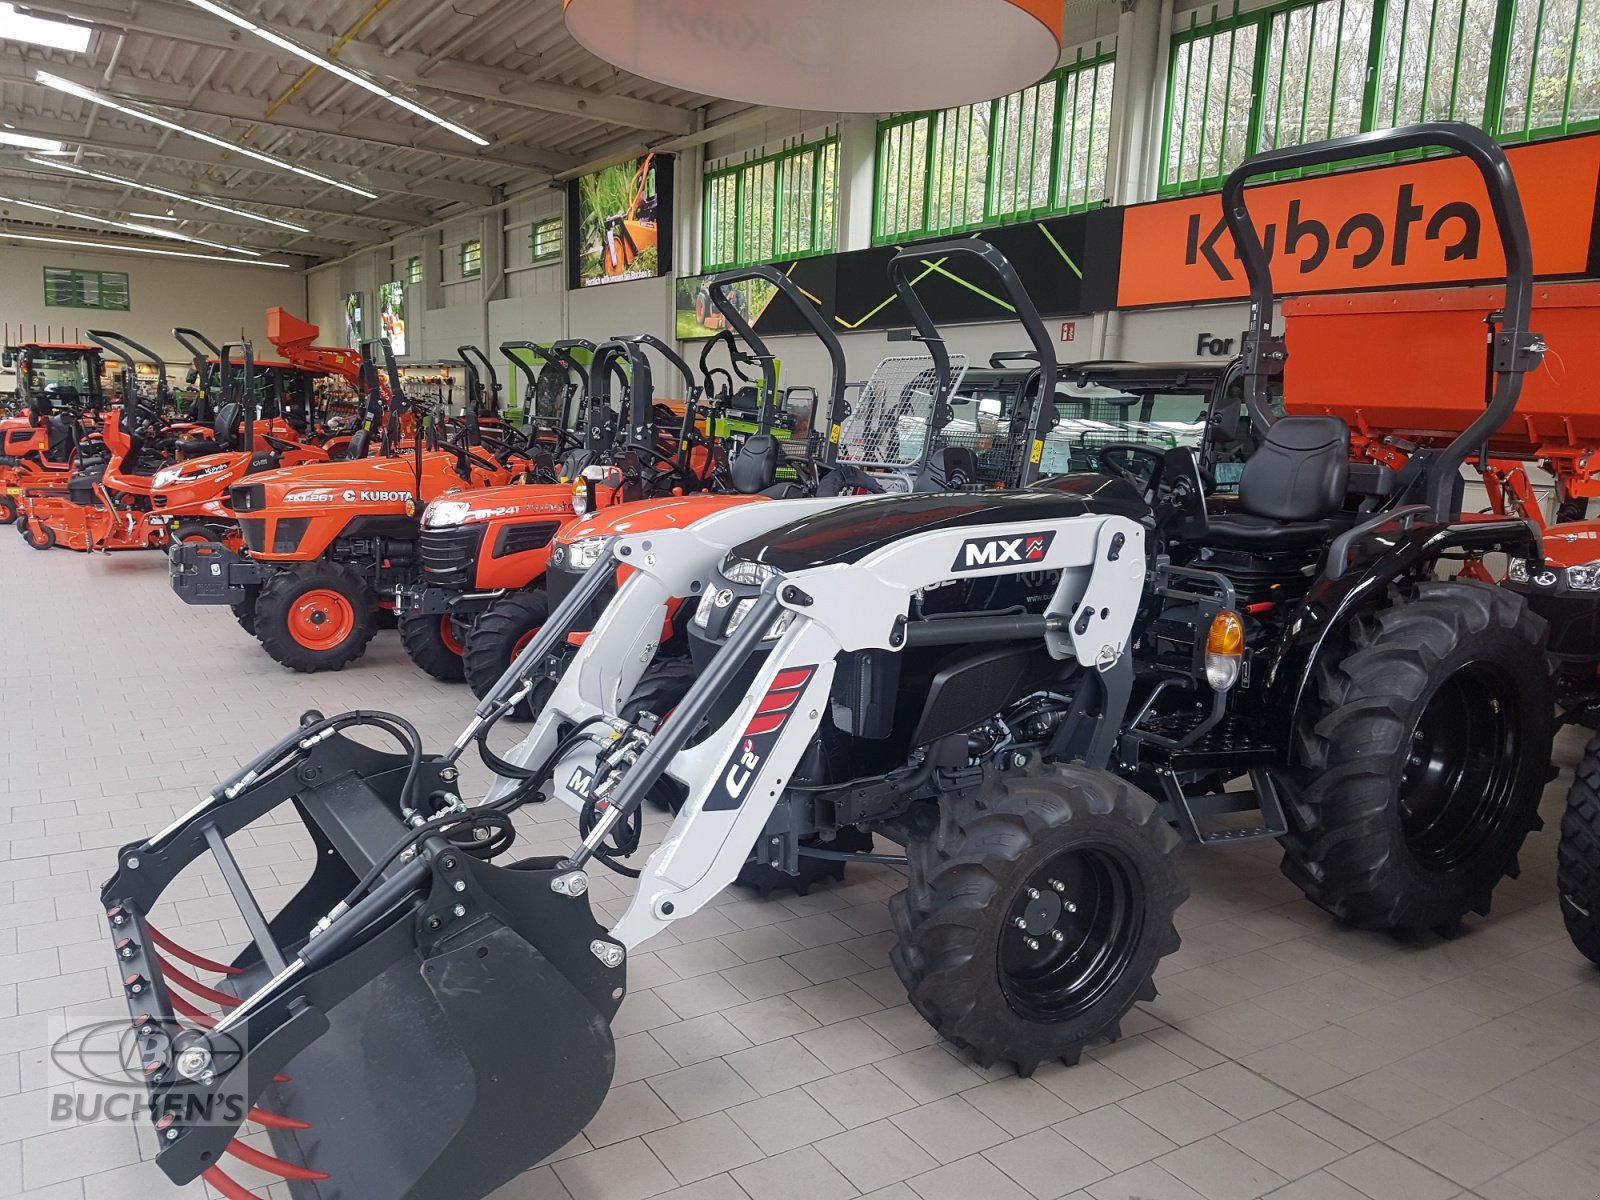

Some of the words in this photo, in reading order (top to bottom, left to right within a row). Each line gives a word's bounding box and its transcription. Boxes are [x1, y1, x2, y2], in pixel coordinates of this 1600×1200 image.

[1196, 332, 1234, 356] For
[360, 491, 413, 502] KUBOTA
[965, 538, 1024, 567] MX
